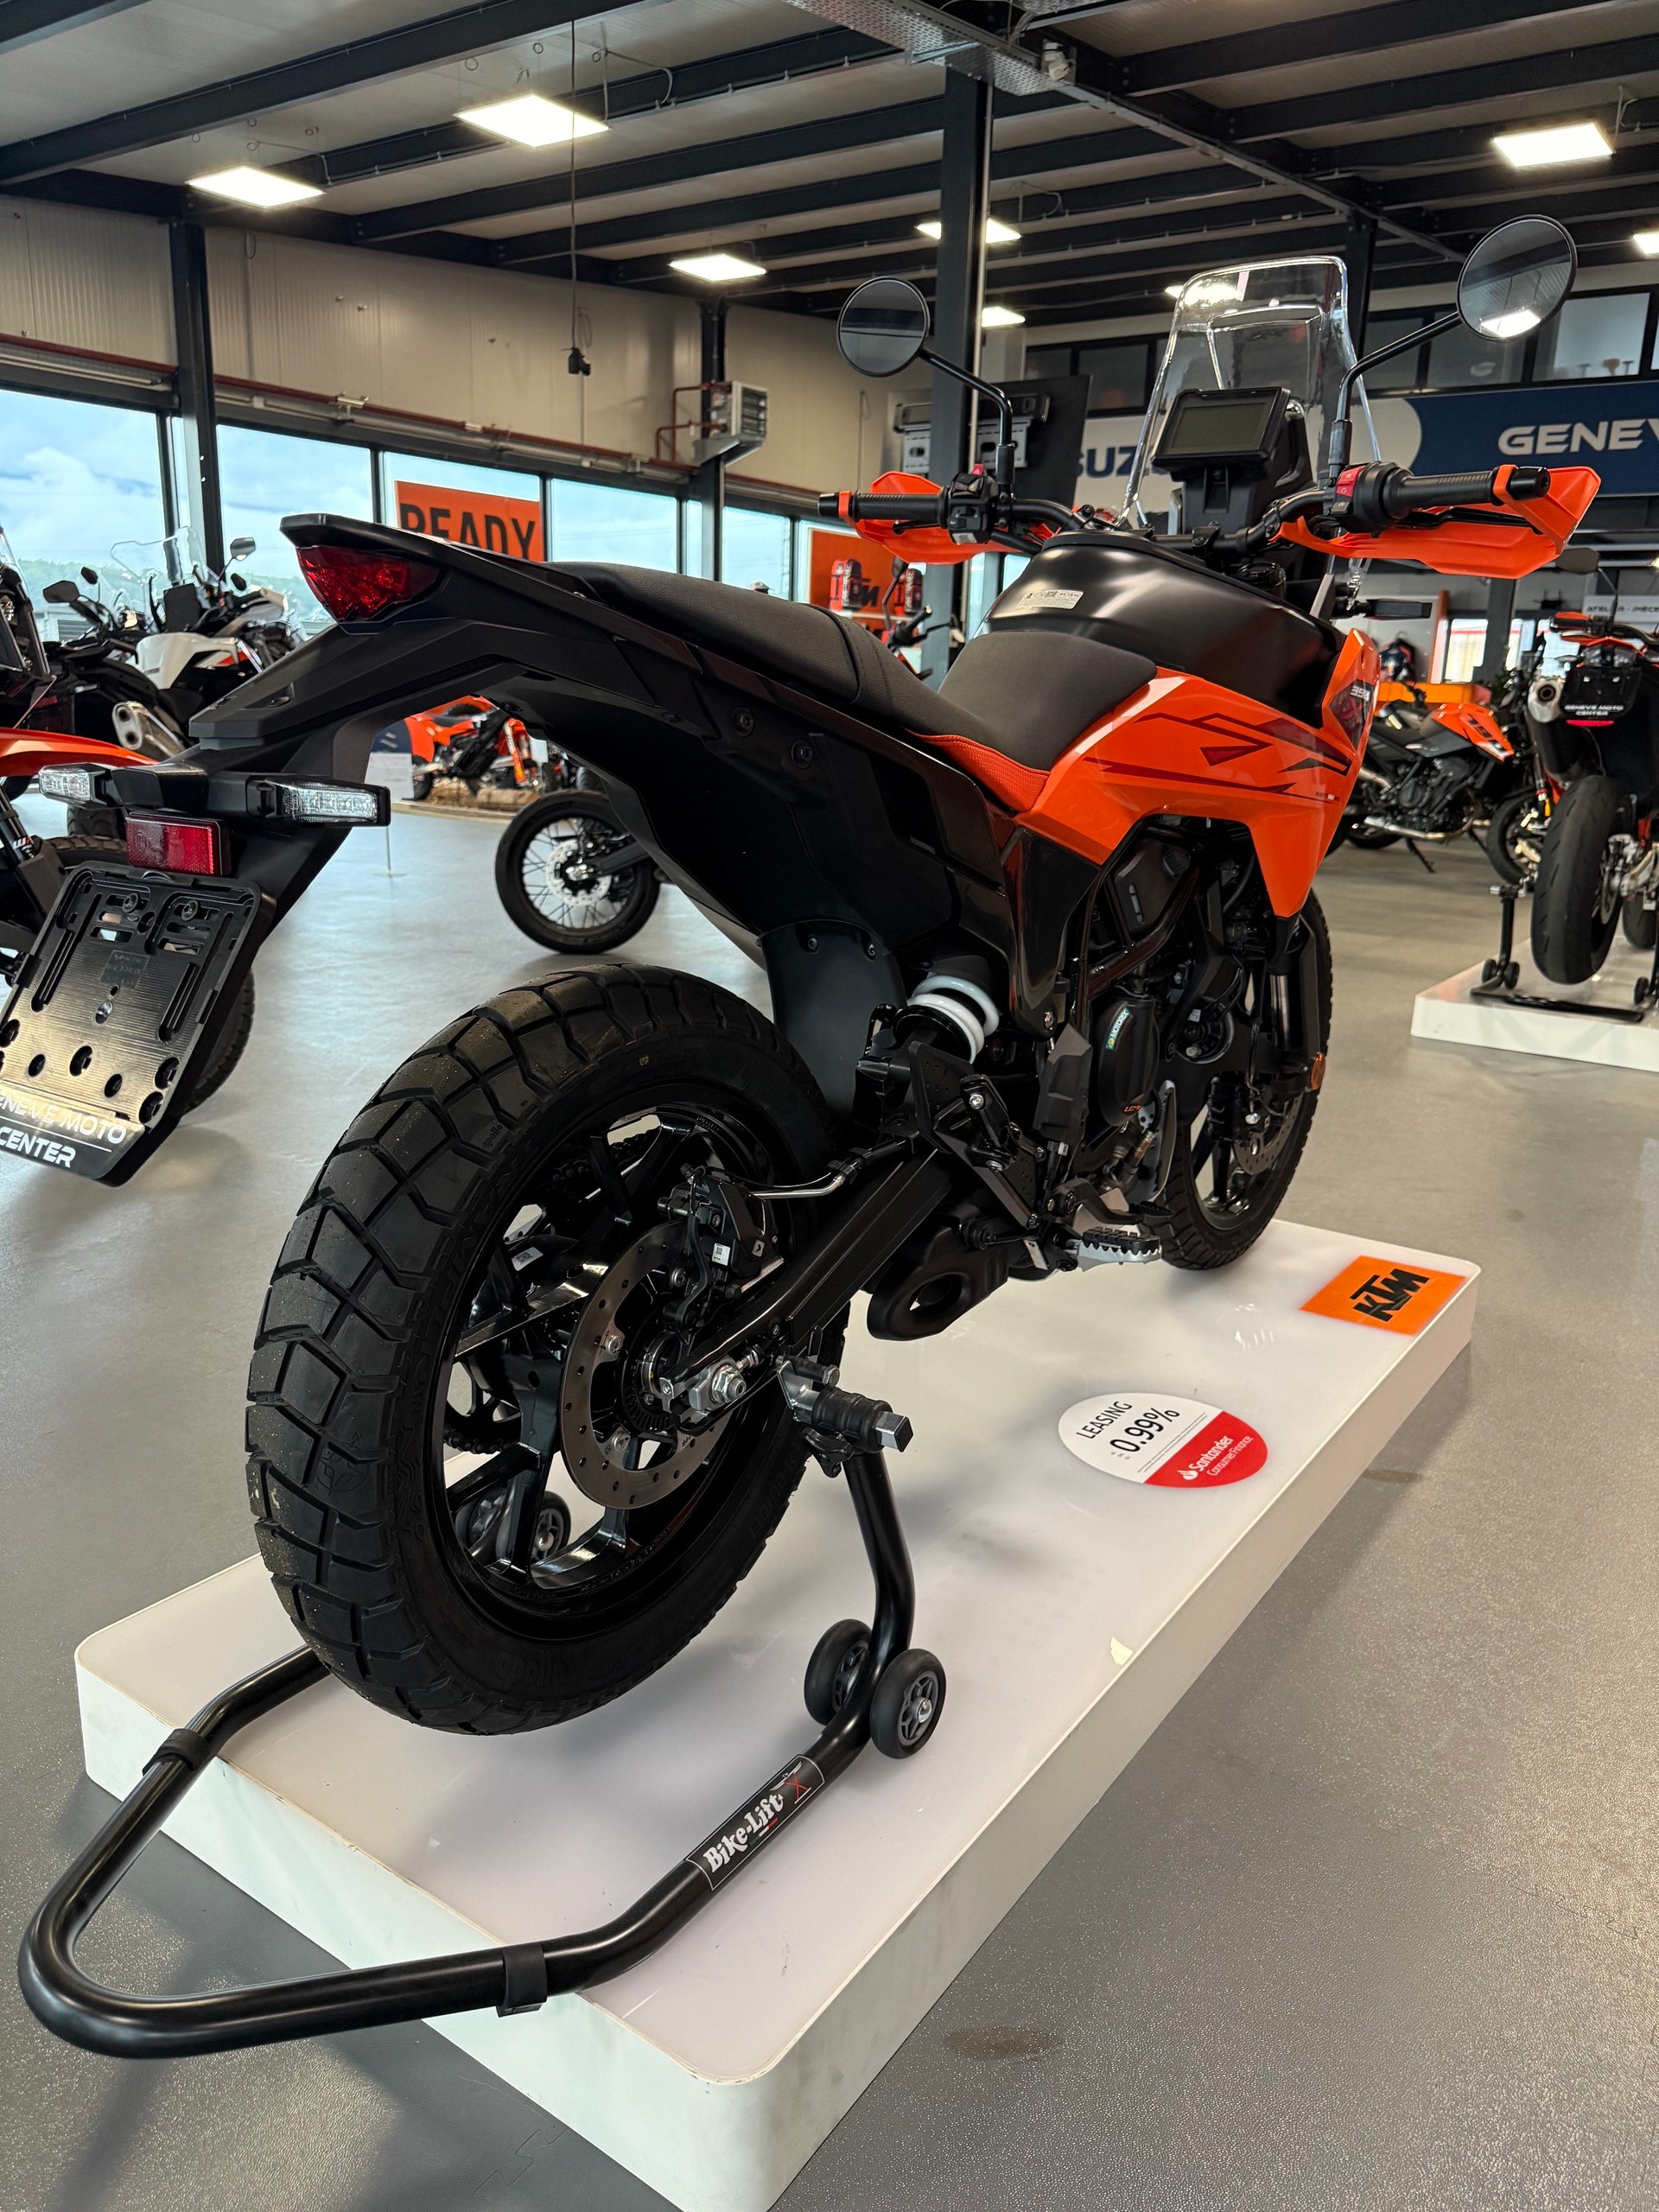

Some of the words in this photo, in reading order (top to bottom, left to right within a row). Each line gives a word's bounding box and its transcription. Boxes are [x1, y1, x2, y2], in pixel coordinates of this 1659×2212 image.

[59, 1109, 127, 1144] MOTO
[482, 1124, 504, 1148] apollo
[0, 1126, 76, 1168] CENTER
[1350, 1268, 1430, 1322] KTM
[1076, 1401, 1133, 1440] LEASING
[1109, 1408, 1180, 1452] 0.99%
[1189, 1435, 1234, 1471] Santander
[702, 1793, 785, 1873] Bike-Lift
